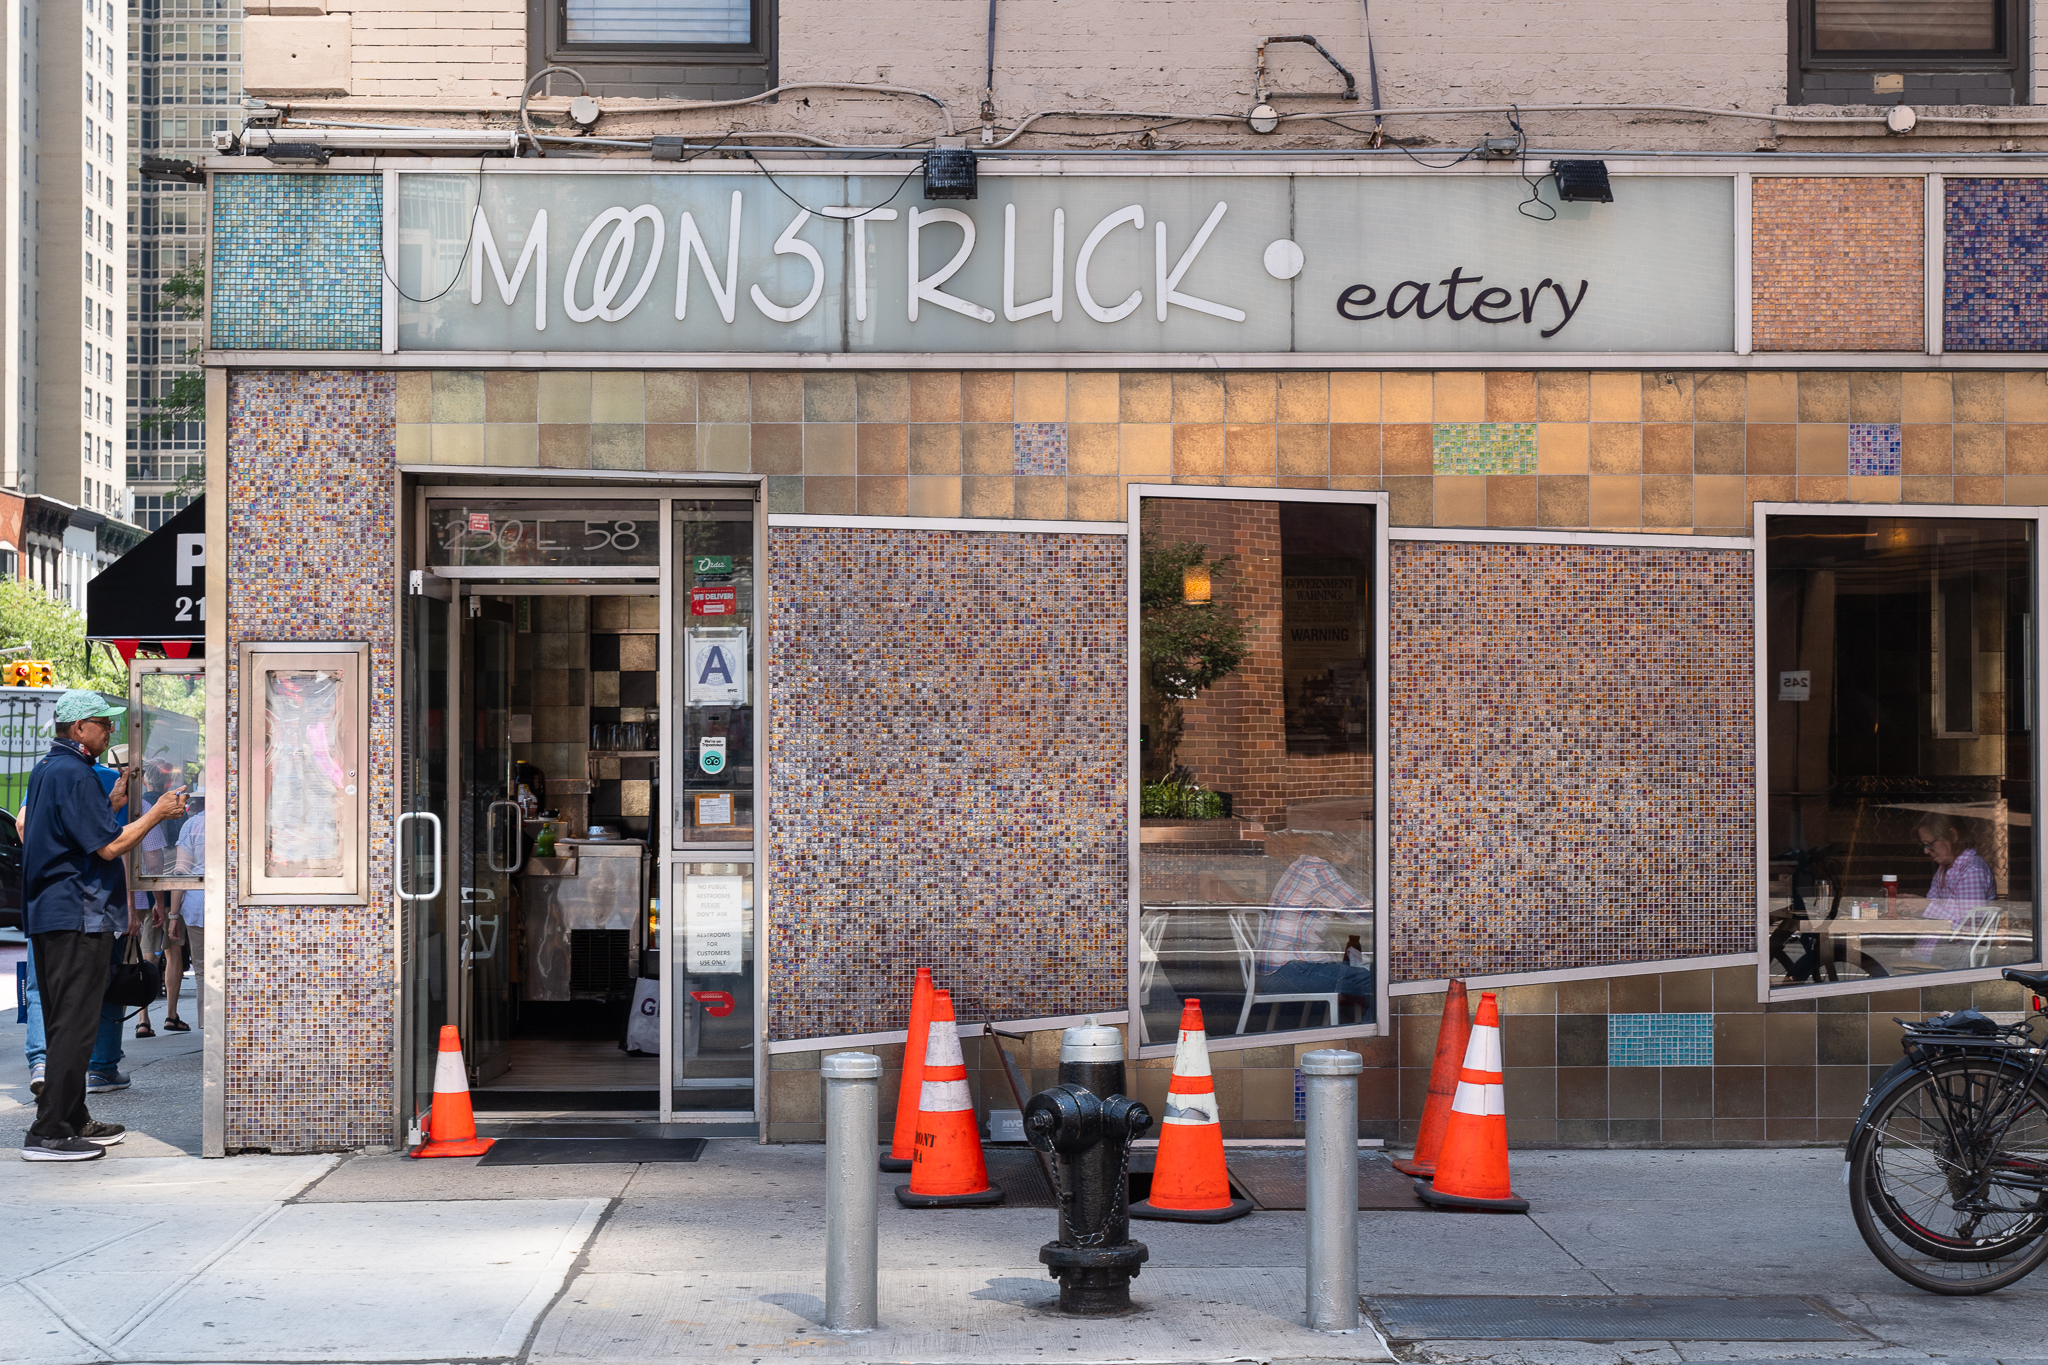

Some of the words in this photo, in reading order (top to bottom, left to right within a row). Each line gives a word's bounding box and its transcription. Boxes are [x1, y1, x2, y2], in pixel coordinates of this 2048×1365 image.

[1337, 266, 1589, 338] eatery
[443, 519, 524, 550] 250
[583, 520, 640, 550] 58
[1286, 578, 1354, 590] GOVERNMENT
[1291, 628, 1349, 642] WARNING
[698, 645, 734, 684] A
